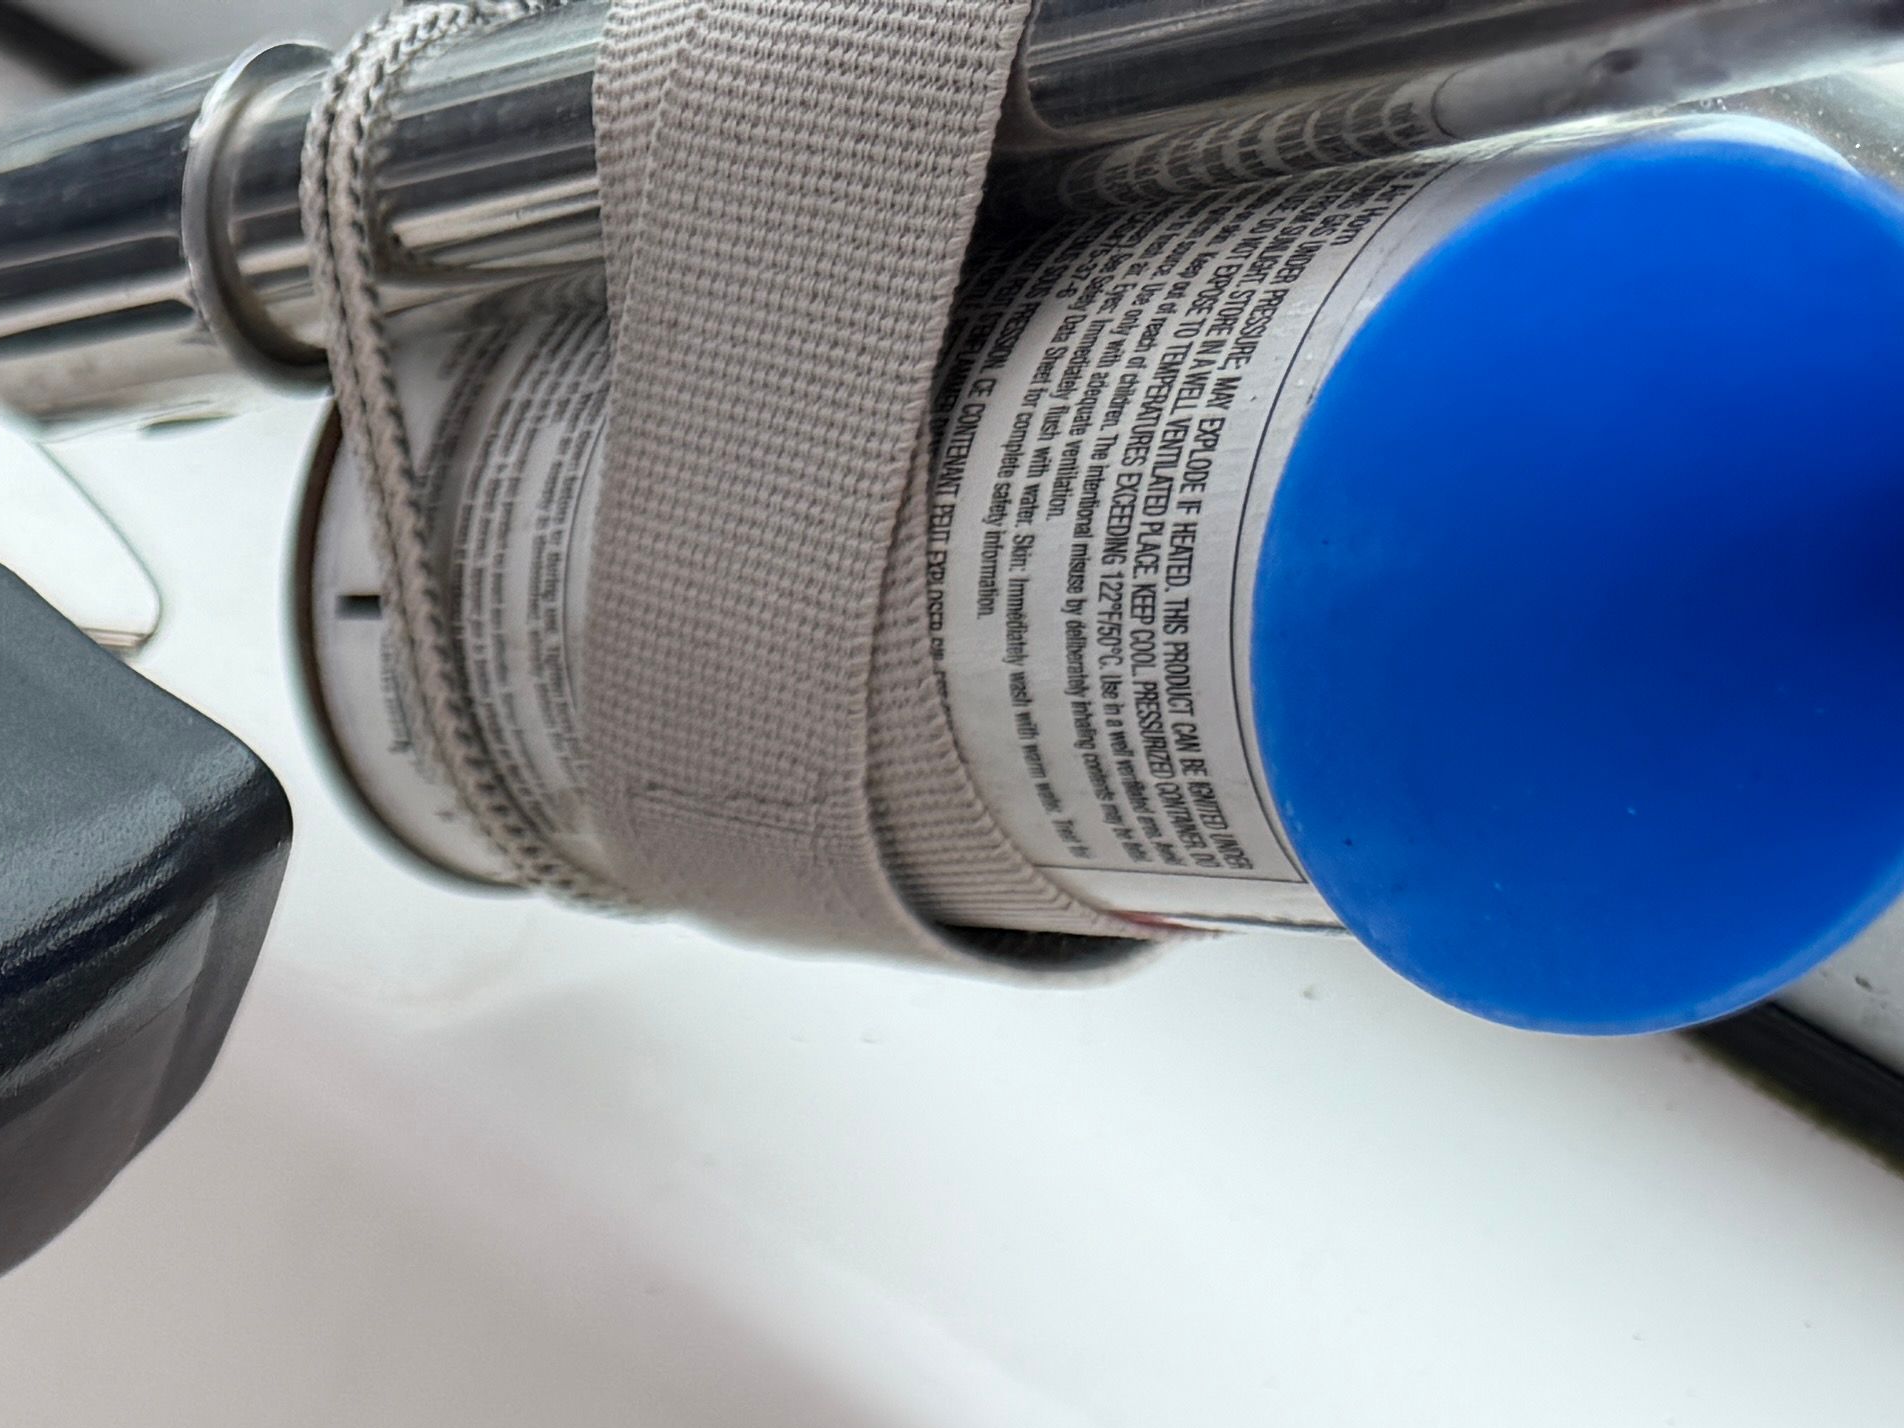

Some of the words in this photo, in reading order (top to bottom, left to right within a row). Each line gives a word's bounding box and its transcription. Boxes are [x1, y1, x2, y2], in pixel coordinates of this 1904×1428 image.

[1309, 215, 1351, 237] GAS
[1330, 207, 1389, 245] Horn
[1176, 252, 1219, 278] Keep
[1226, 236, 1268, 259] NOT
[1237, 226, 1307, 287] SUNLIGHT.
[1269, 241, 1327, 284] UNDER
[1131, 282, 1168, 306] Use
[1154, 303, 1178, 314] of
[1164, 281, 1191, 300] out
[1184, 264, 1245, 316] EXPOSE
[1050, 314, 1089, 344] Data
[1109, 309, 1145, 336] only
[1172, 319, 1208, 338] TO
[1206, 290, 1258, 337] STORE
[1217, 289, 1290, 369] PRESSURE;
[978, 302, 1042, 374] PRESSION.
[1096, 339, 1129, 369] with
[1133, 317, 1169, 353] reach
[1196, 340, 1229, 354] IN
[1029, 346, 1070, 385] Sheet
[1048, 319, 1116, 400] Immediately
[1124, 356, 1148, 369] of
[1190, 359, 1219, 370] A
[968, 380, 997, 398] CE
[1021, 387, 1050, 409] for
[1068, 372, 1113, 436] adequate
[1099, 373, 1141, 431] children.
[1120, 341, 1195, 467] TEMPERATURES
[1169, 372, 1214, 415] WELL
[1205, 377, 1242, 410] MAY
[1036, 405, 1072, 441] flush
[934, 404, 987, 500] CONTENANT
[995, 412, 1036, 478] complete
[1026, 446, 1054, 478] with
[1090, 434, 1120, 461] The
[1179, 418, 1226, 494] EXPLODE
[1044, 439, 1084, 523] ventilation.
[1142, 419, 1193, 516] VENTILATED
[981, 482, 1013, 527] safety
[1013, 482, 1043, 529] water.
[1072, 464, 1110, 538] intentional
[1100, 473, 1144, 565] EXCEEDING
[1176, 500, 1205, 515] IF
[1007, 534, 1036, 573] Skin:
[1065, 543, 1090, 594] misuse
[1132, 522, 1166, 579] PLACE.
[1164, 522, 1200, 592] HEATED.
[976, 530, 1008, 620] information.
[1000, 578, 1033, 666] Immediately
[1059, 598, 1089, 616] by
[1130, 583, 1157, 625] KEEP
[1162, 598, 1191, 635] THIS
[1063, 620, 1090, 698] deliberately
[1129, 629, 1158, 677] COOL.
[1007, 671, 1034, 707] wash
[1099, 674, 1125, 699] Use
[1162, 643, 1195, 717] PRODUCT
[1013, 711, 1041, 741] with
[1072, 701, 1098, 749] inhaling
[1102, 703, 1126, 715] in
[1104, 719, 1124, 728] a
[1106, 731, 1135, 757] well
[1132, 681, 1177, 779] PRESSURIZED
[1171, 723, 1202, 752] CAN
[1179, 758, 1209, 778] BE
[1186, 781, 1229, 830] IGNITED
[1189, 854, 1223, 868] DO
[1209, 834, 1254, 870] UNDER
